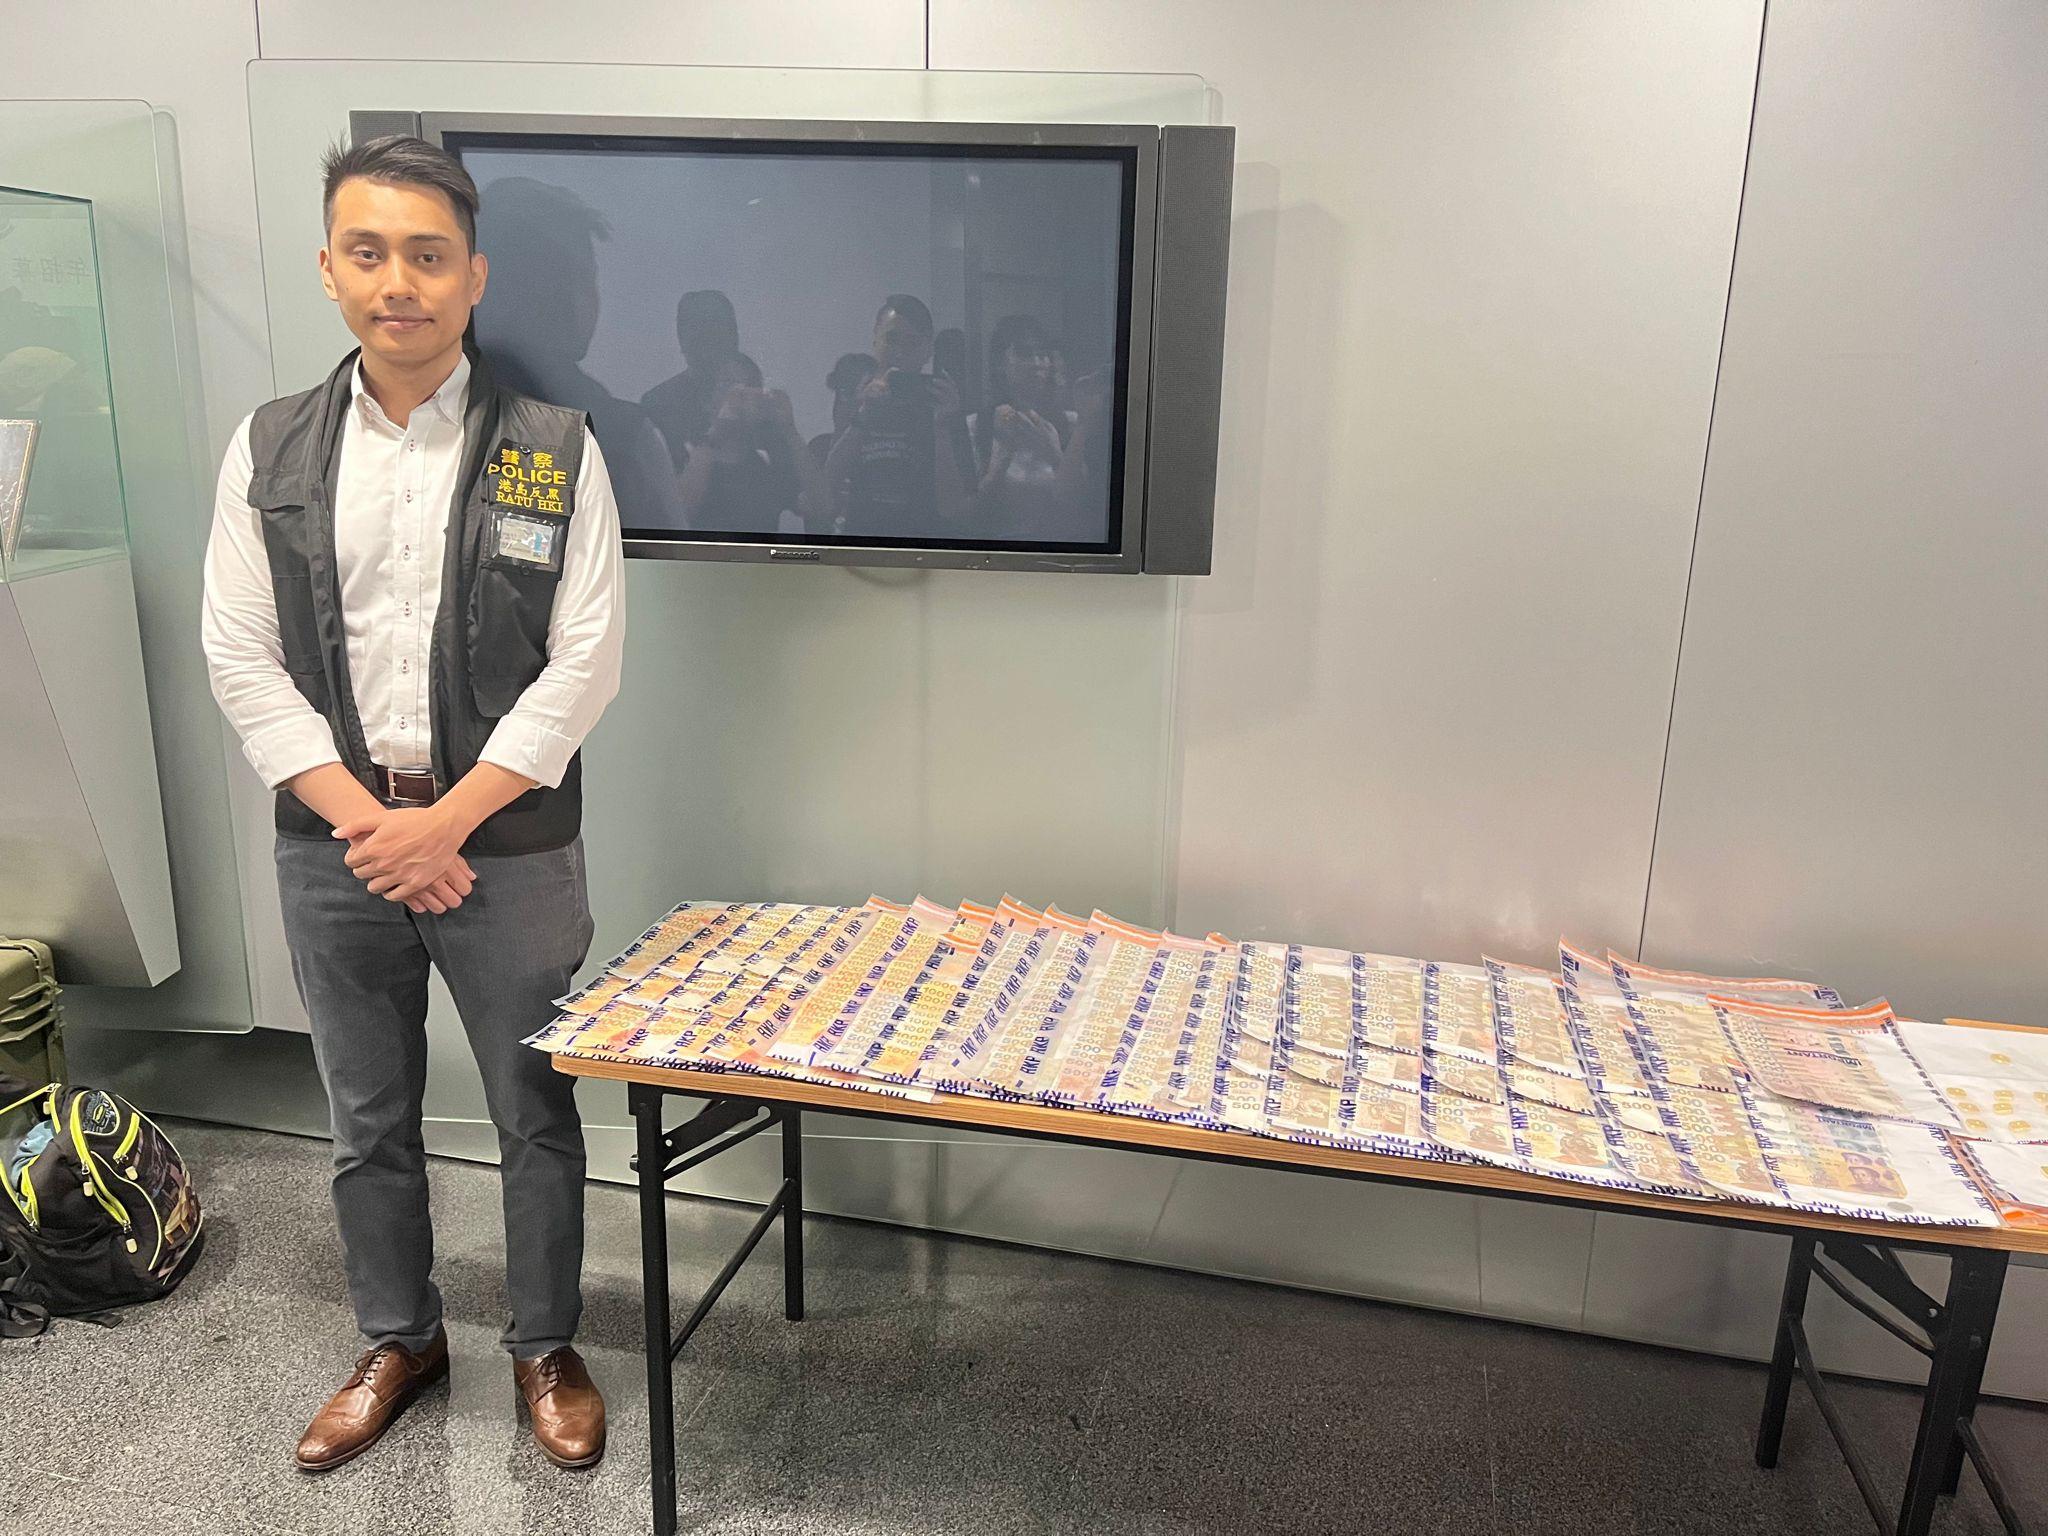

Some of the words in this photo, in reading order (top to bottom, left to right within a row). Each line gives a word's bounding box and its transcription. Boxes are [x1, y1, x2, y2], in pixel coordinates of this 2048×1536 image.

[501, 448, 553, 468] 警察
[487, 463, 567, 485] POLICE
[496, 490, 534, 508] RATU
[537, 499, 564, 513] HKI
